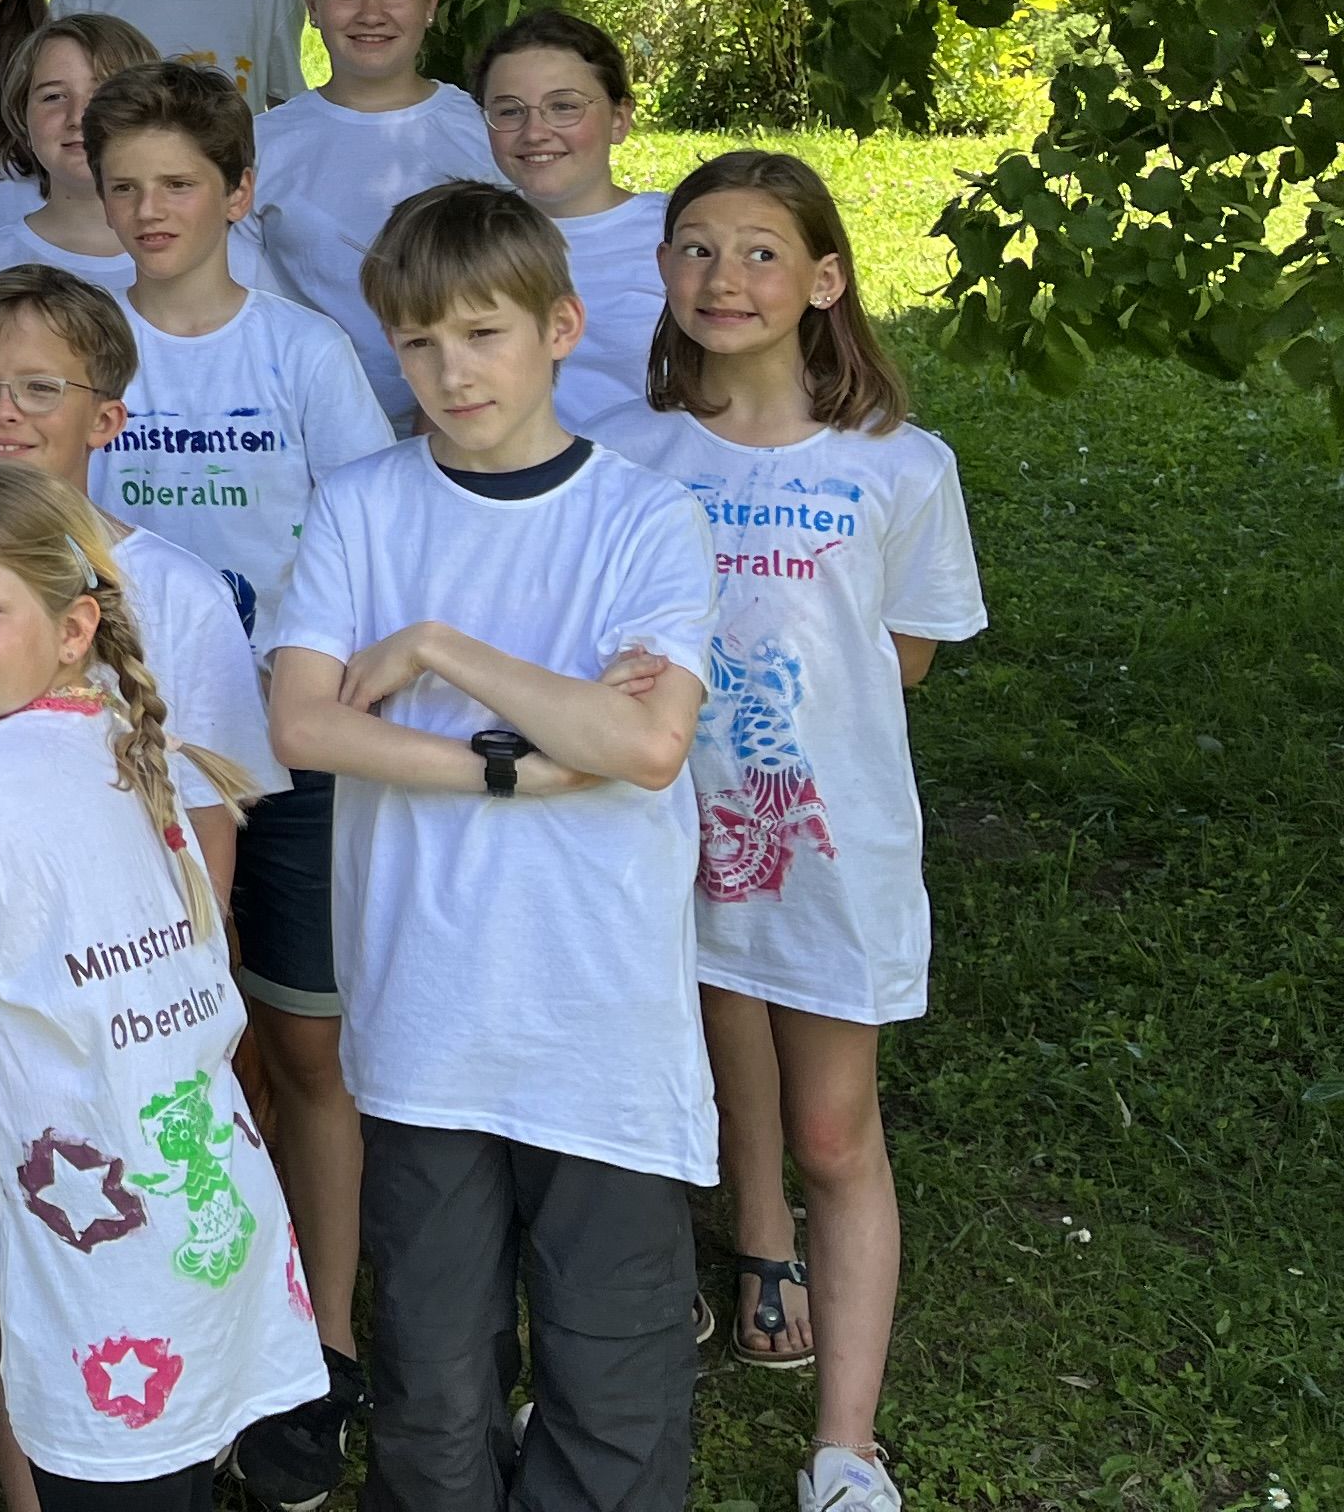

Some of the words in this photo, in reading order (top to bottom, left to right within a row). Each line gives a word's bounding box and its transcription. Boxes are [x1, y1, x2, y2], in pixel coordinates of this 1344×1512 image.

[121, 479, 249, 508] Oberalm
[715, 549, 815, 581] eralm
[110, 986, 219, 1051] Oberalm
